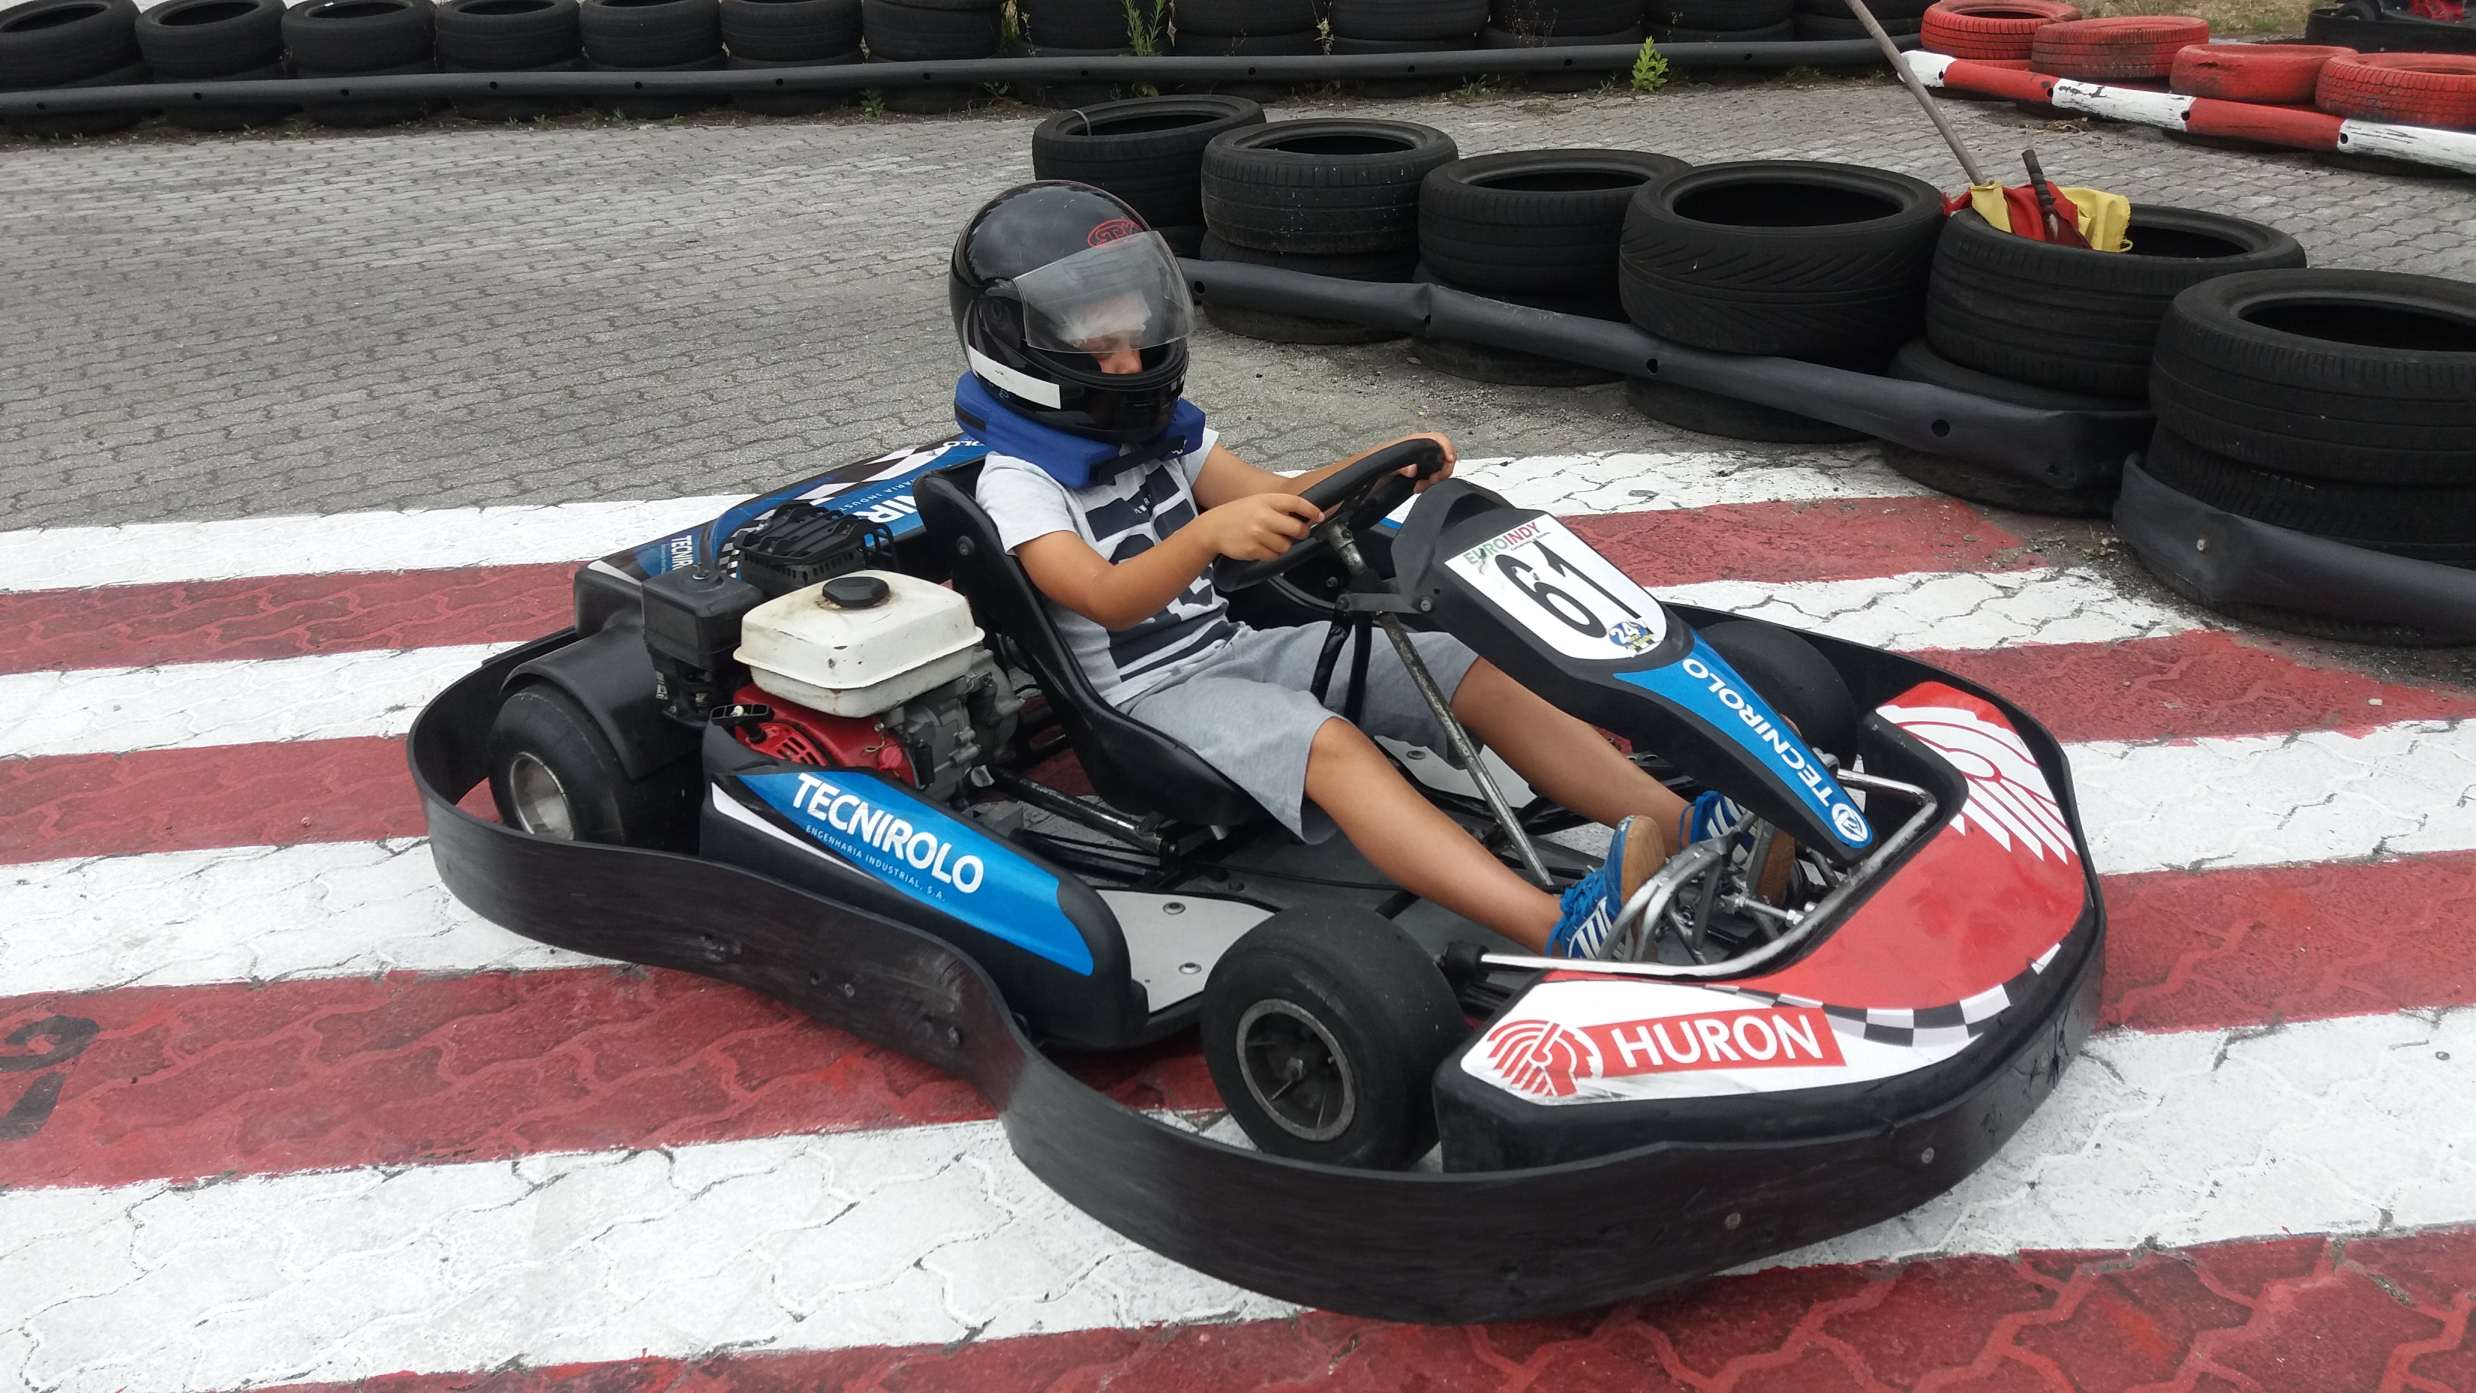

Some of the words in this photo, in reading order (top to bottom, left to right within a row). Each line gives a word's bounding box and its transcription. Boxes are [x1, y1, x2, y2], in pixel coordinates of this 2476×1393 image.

[671, 535, 693, 571] TECNIR
[1495, 539, 1642, 638] 61
[1682, 658, 1833, 807] TECNIROLO
[792, 772, 985, 894] TECNIROLO
[805, 824, 862, 859] ENGENHARIA
[1610, 1013, 1824, 1069] HURON
